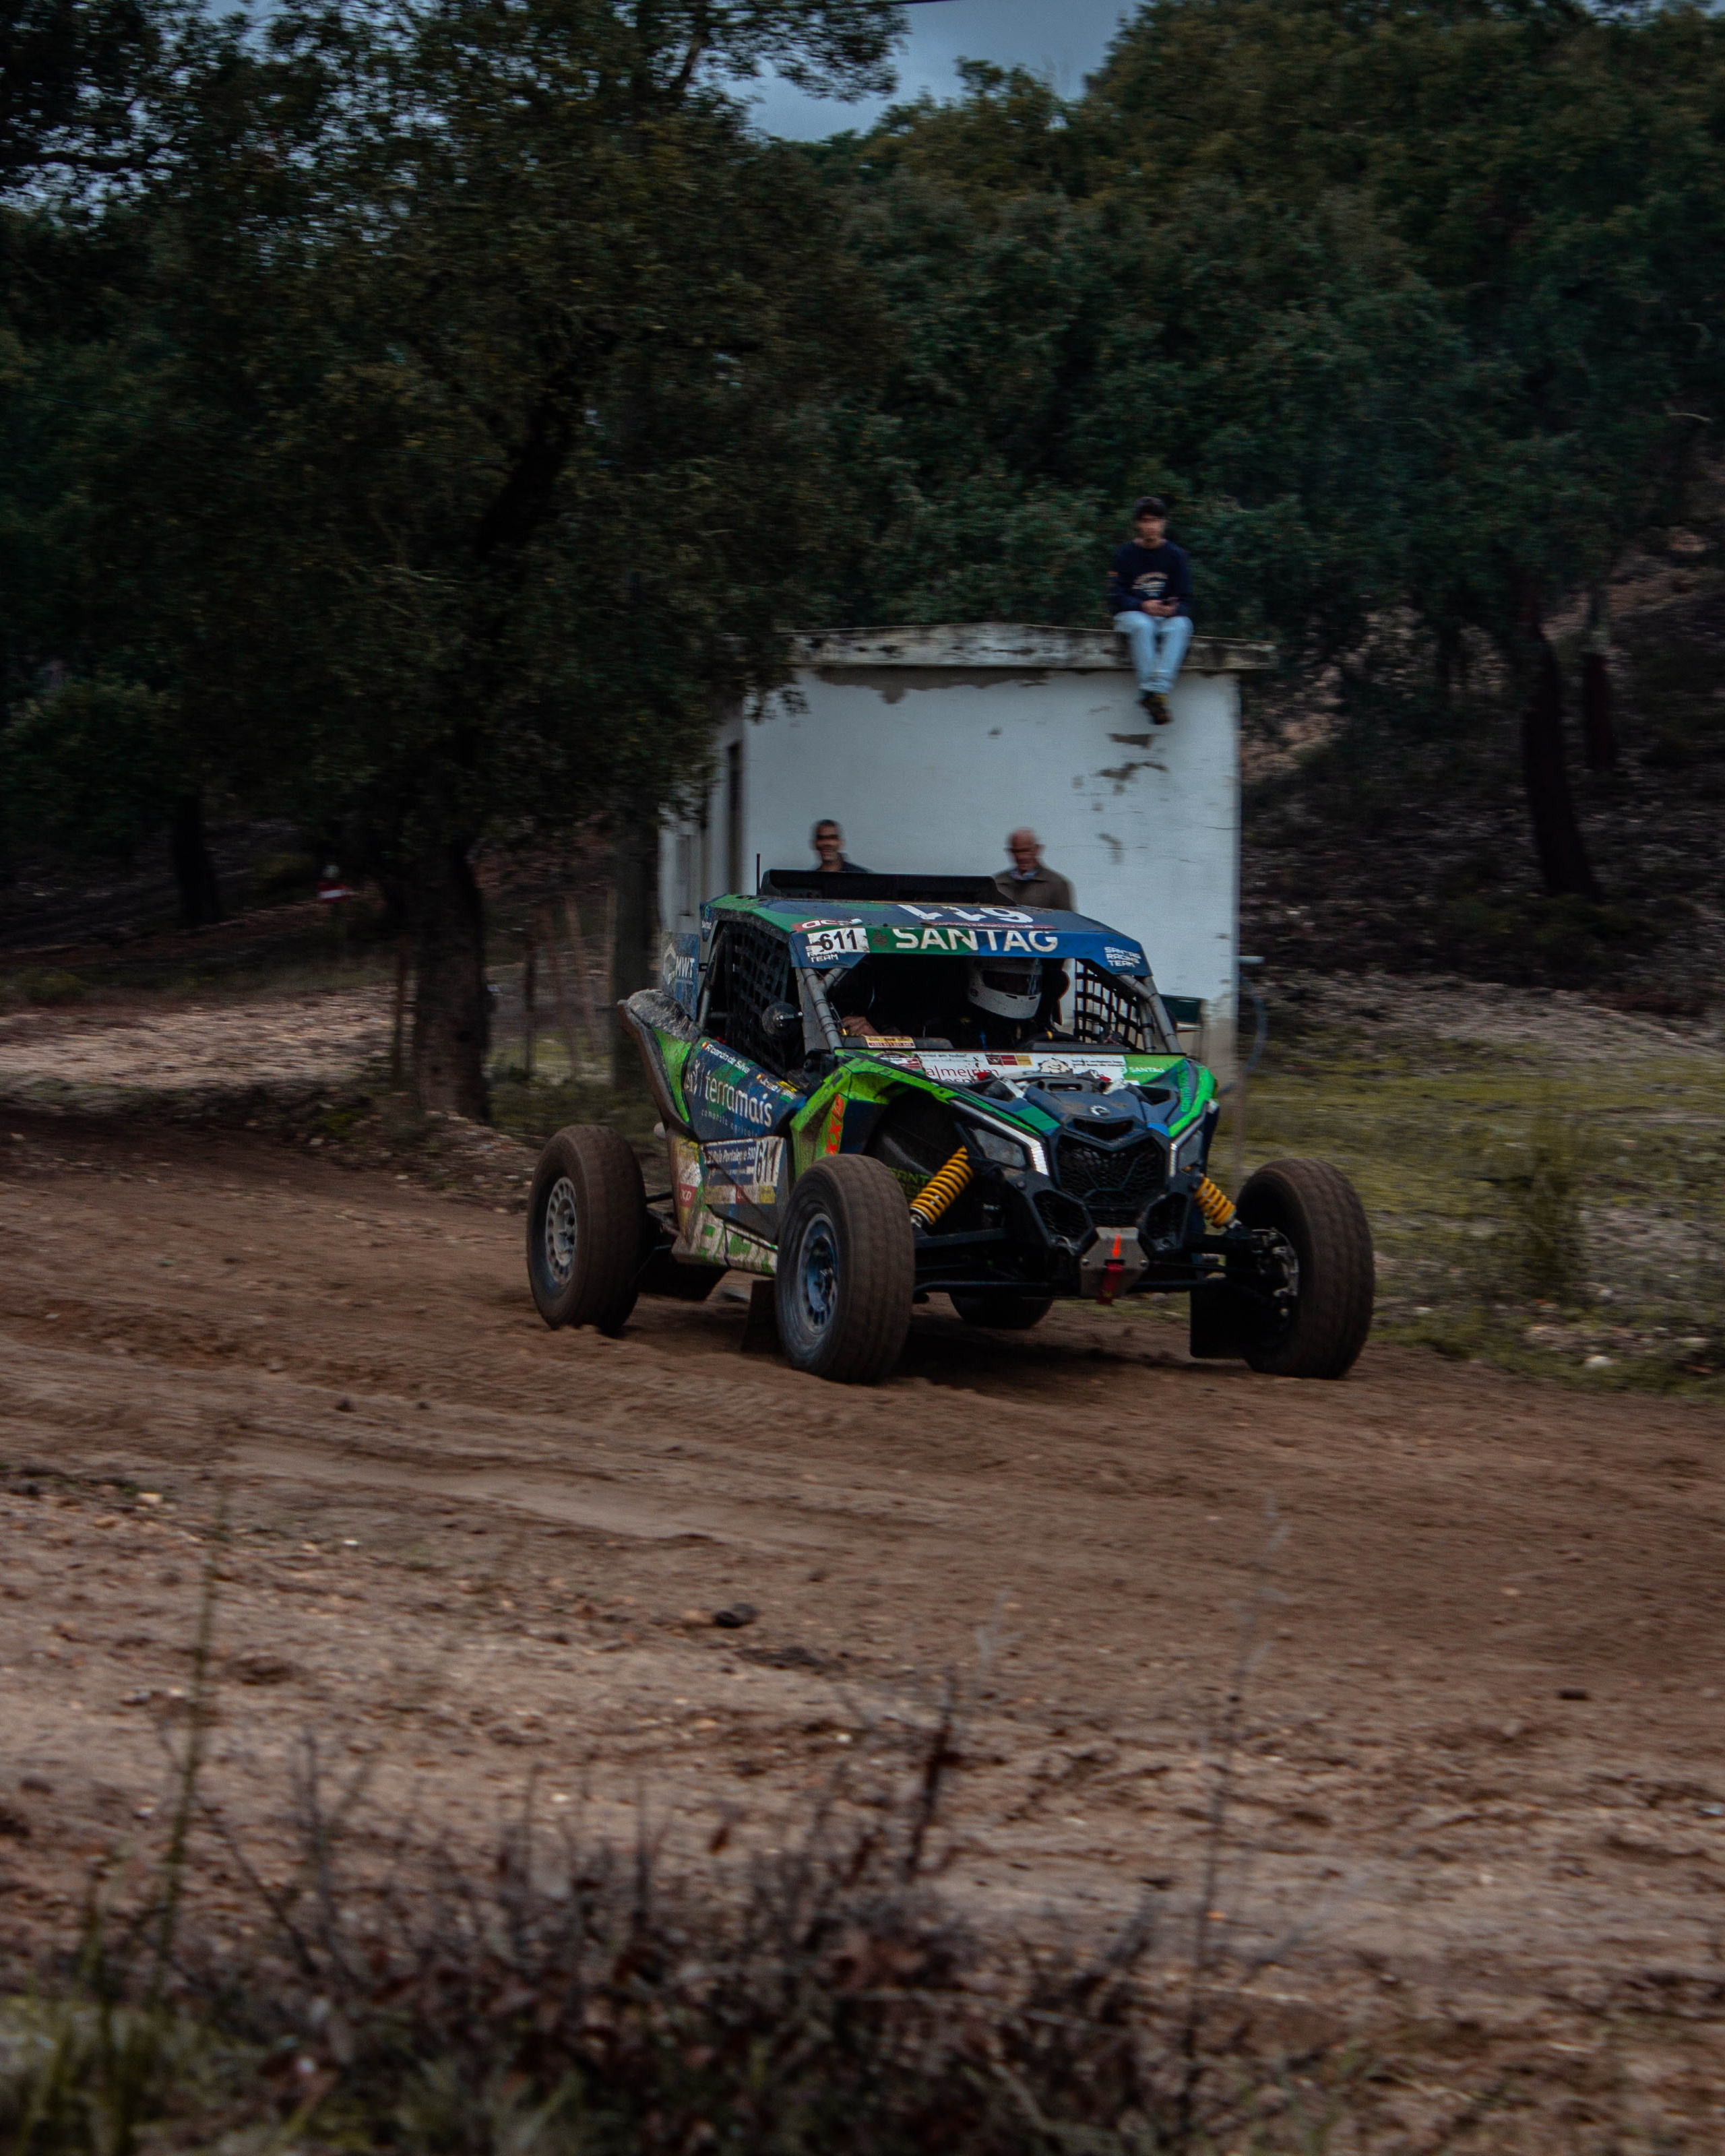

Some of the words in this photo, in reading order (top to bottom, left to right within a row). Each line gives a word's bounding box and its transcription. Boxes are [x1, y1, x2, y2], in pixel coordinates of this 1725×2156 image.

[819, 929, 858, 951] 611
[892, 928, 1059, 953] SANTAG
[811, 953, 839, 963] TEAM
[705, 1070, 773, 1128] terramais
